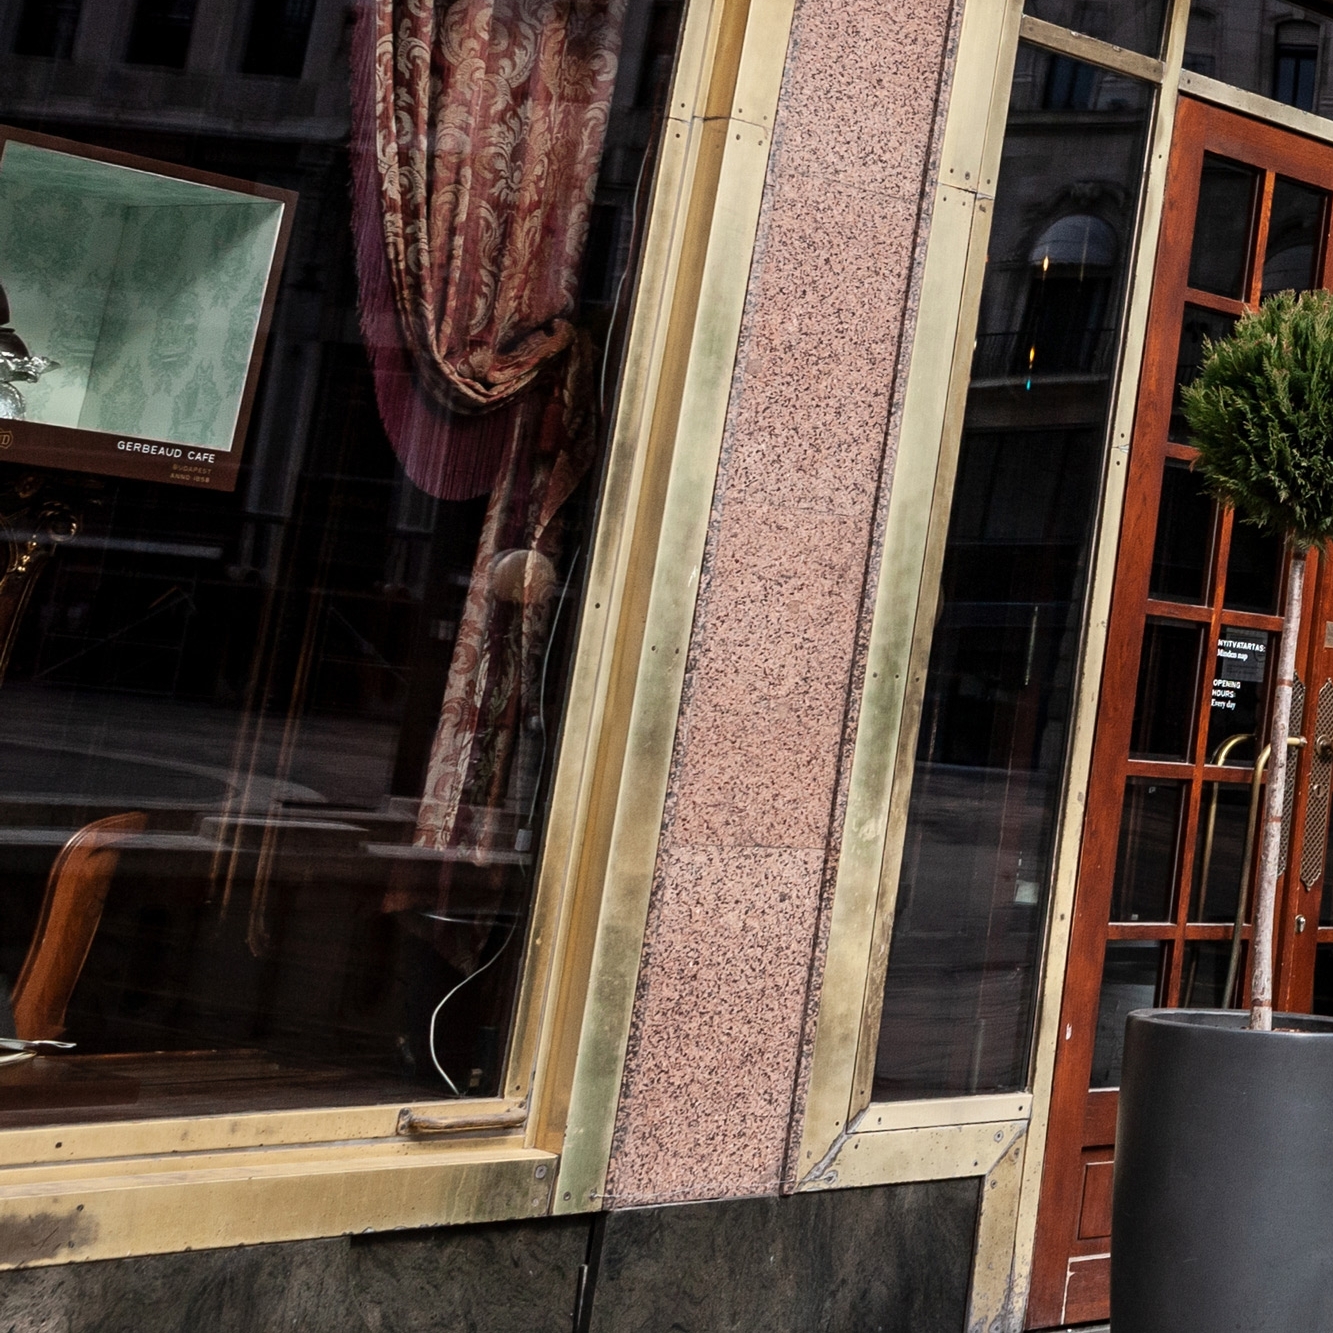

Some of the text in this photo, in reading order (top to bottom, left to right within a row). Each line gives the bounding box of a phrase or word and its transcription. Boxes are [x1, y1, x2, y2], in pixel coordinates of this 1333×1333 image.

[117, 440, 216, 464] GERBEAUD CAFE
[1212, 678, 1241, 689] OPENING
[1210, 698, 1226, 709] Every
